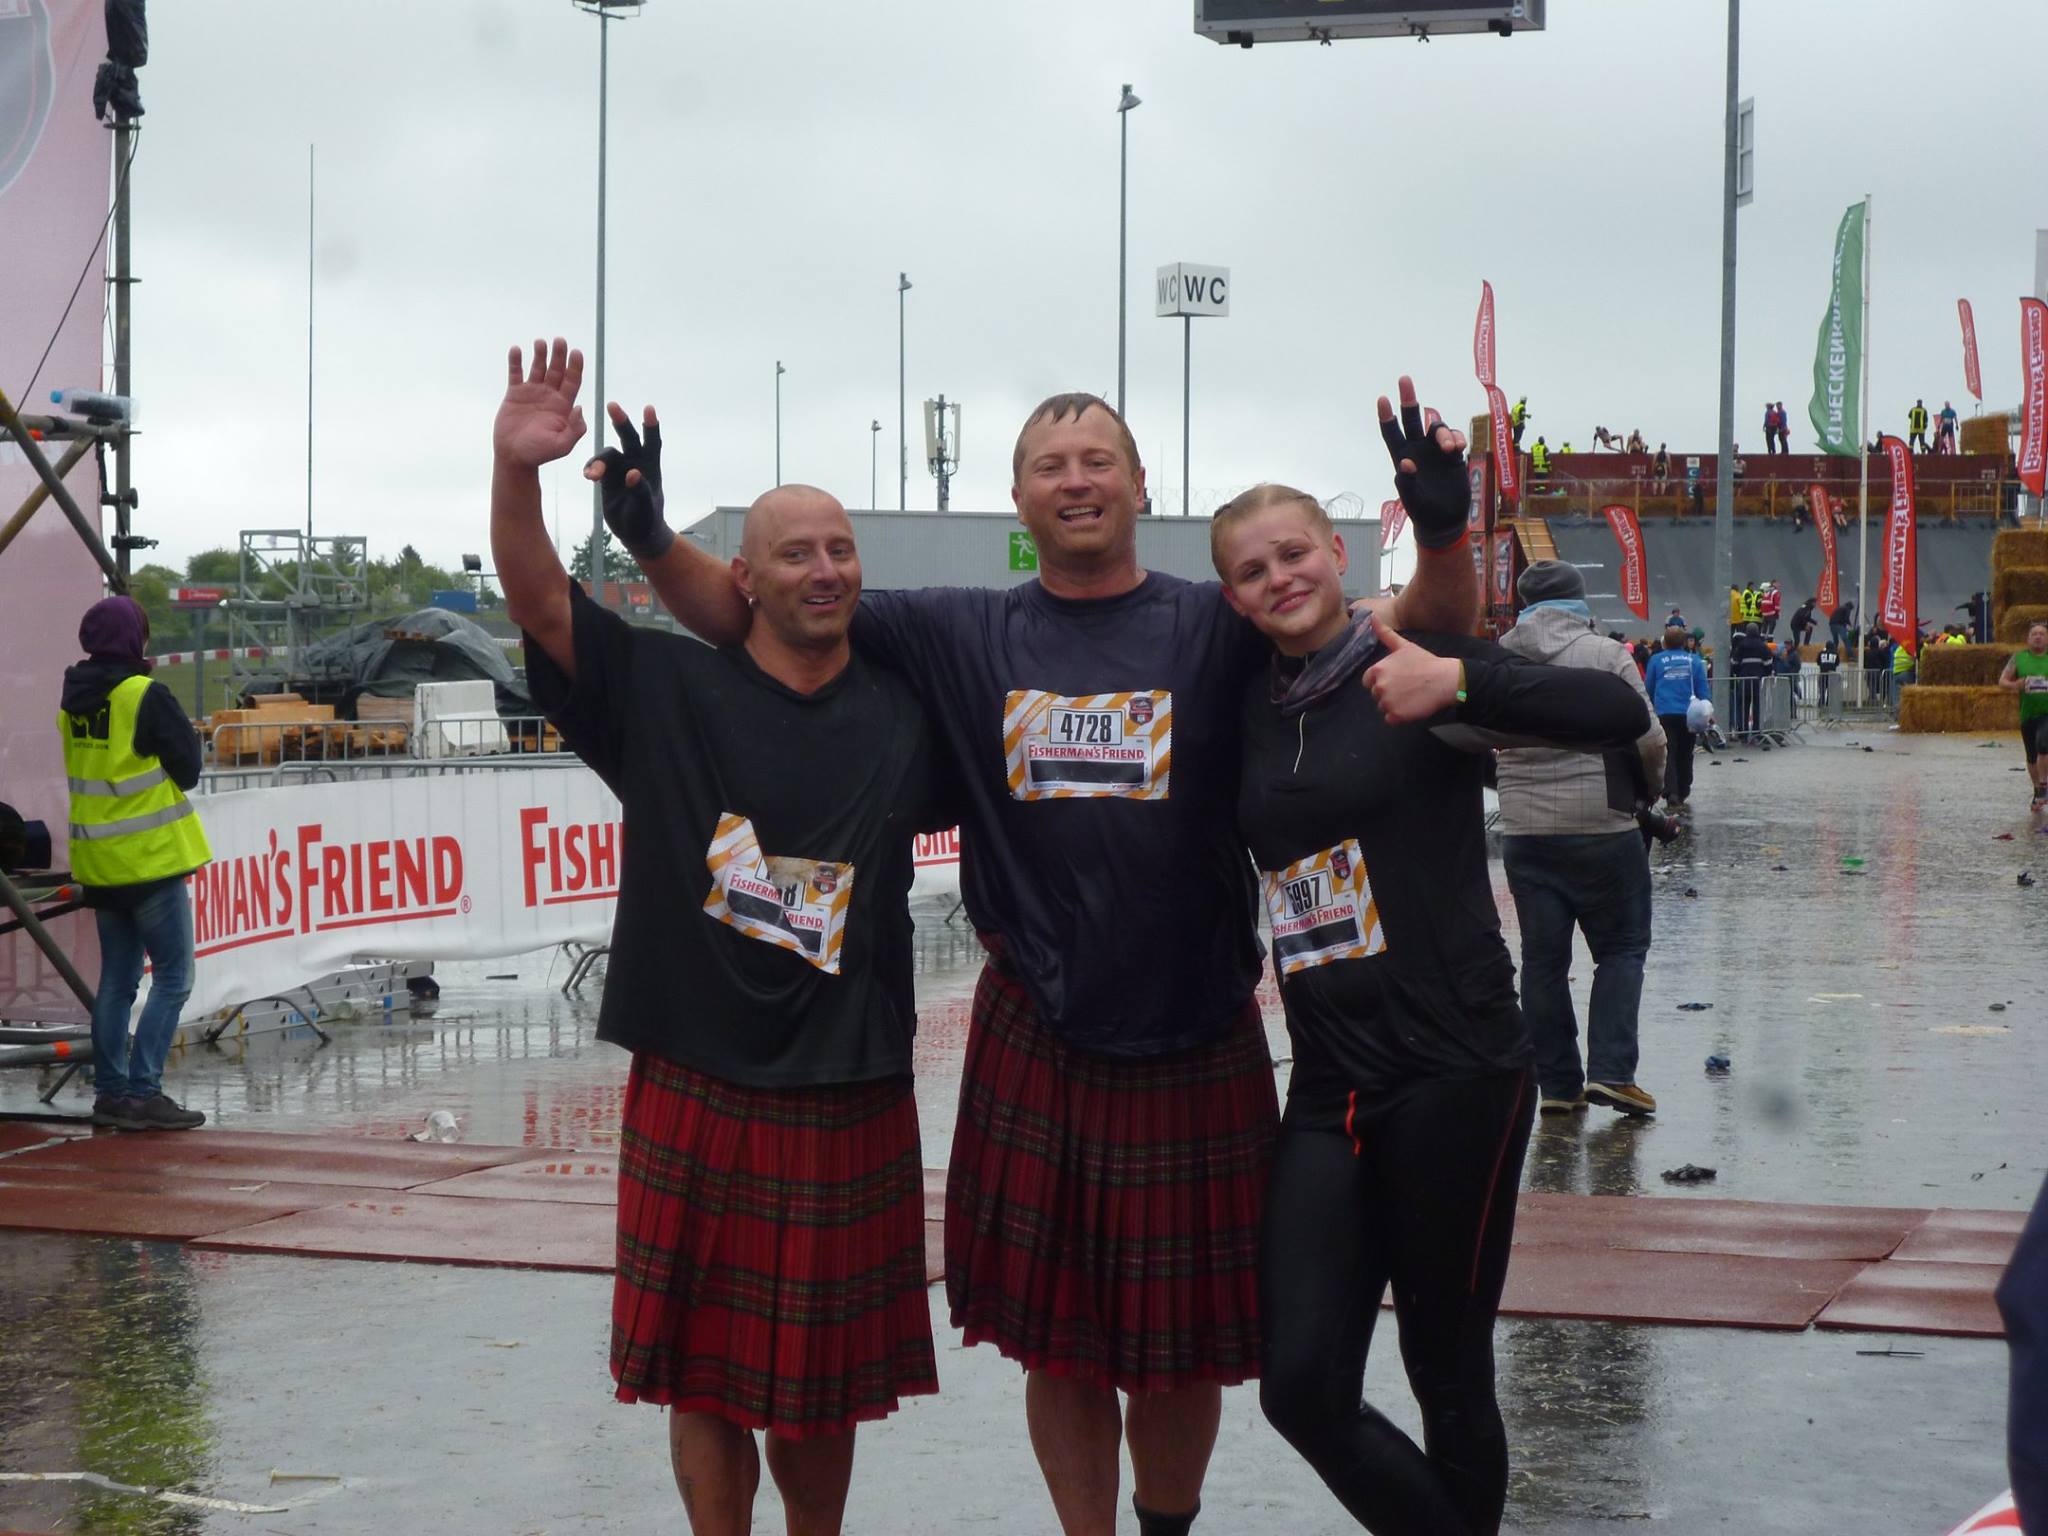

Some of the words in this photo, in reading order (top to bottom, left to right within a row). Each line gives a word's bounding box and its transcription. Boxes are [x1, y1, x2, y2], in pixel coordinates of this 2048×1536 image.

[1158, 274, 1177, 304] WC
[1183, 274, 1225, 304] WC
[1060, 713, 1113, 742] 4728
[1028, 744, 1101, 759] FISHERMAN'S
[1102, 747, 1144, 760] FRIEND
[519, 806, 623, 908] FISH
[297, 823, 464, 934] FRIEND
[1285, 876, 1320, 915] 5997
[1317, 904, 1354, 924] FRIEND
